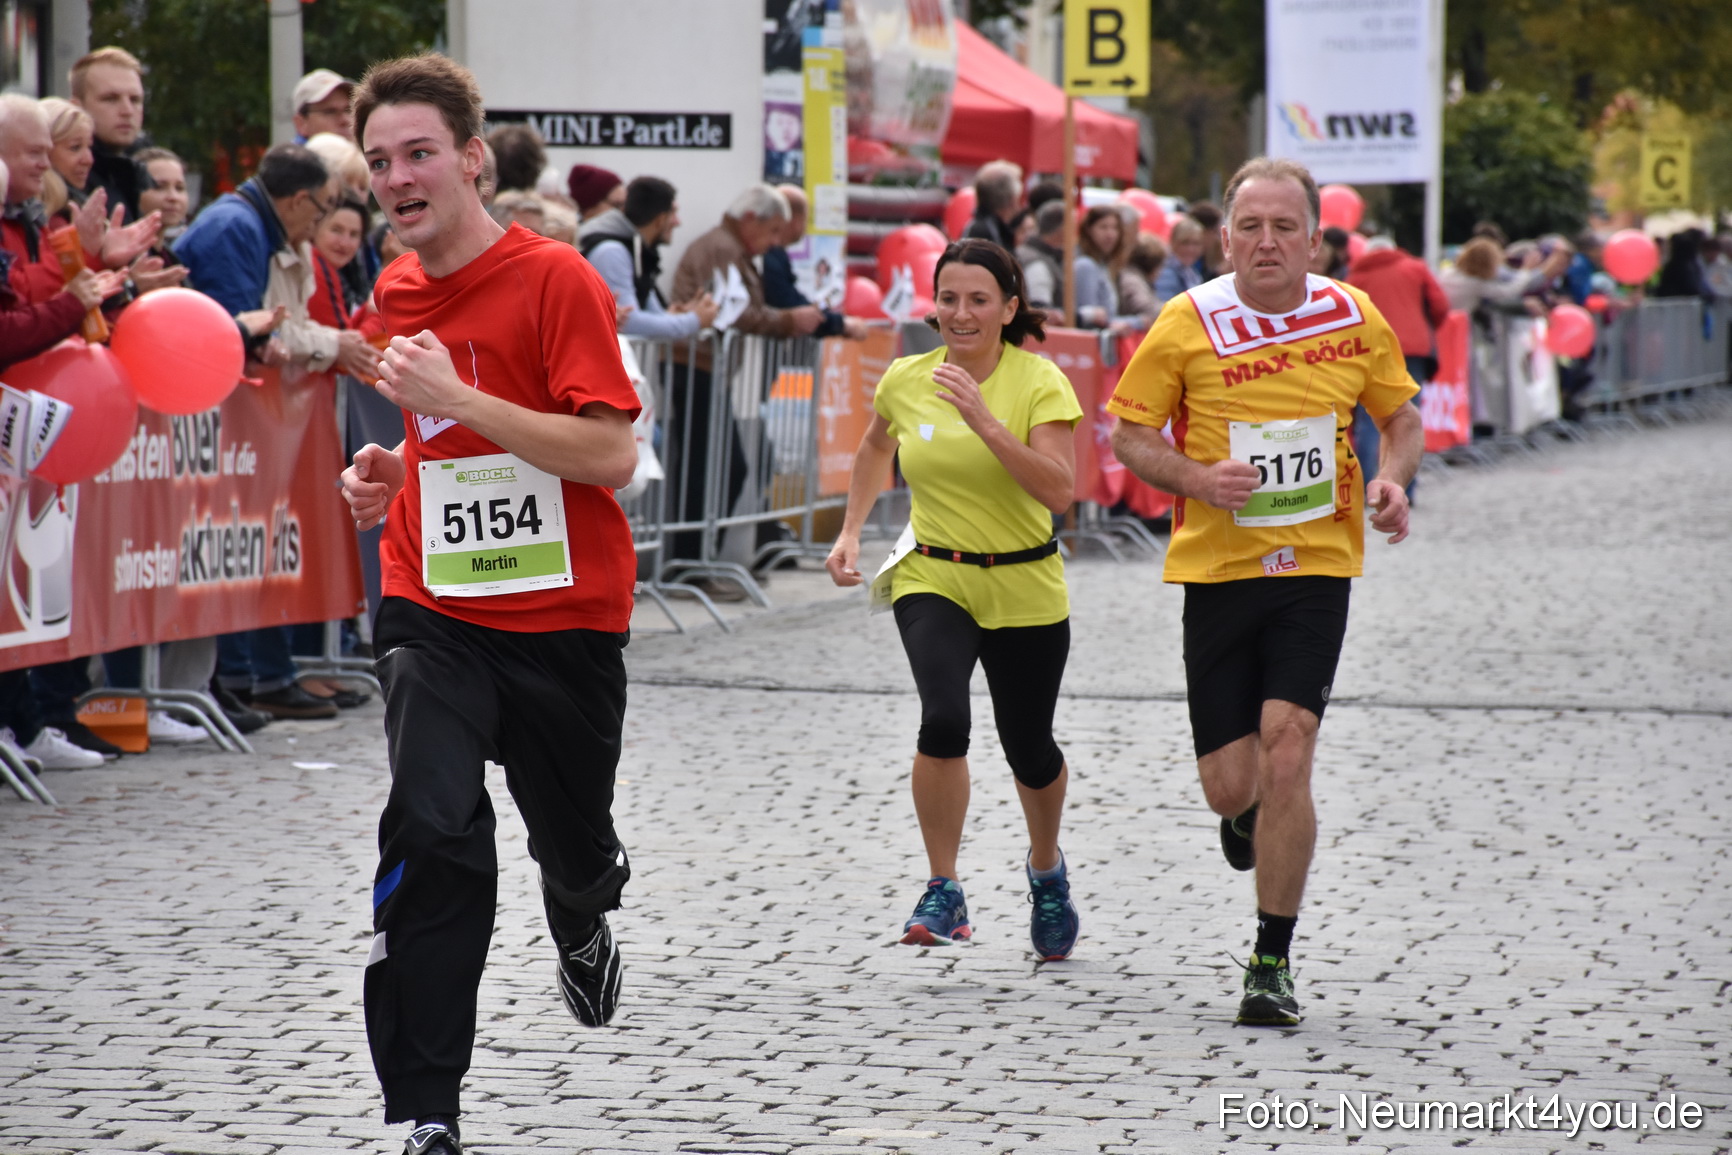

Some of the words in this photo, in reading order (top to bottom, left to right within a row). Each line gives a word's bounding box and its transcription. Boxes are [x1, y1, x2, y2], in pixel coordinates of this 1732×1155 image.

[1088, 8, 1125, 65] B
[484, 114, 723, 146] MINI-Partl.de
[1653, 155, 1677, 191] C
[1221, 352, 1296, 388] MAX
[1303, 339, 1371, 365] BÖGL
[467, 467, 516, 481] BOCK
[1249, 447, 1323, 485] 5176
[443, 494, 542, 544] 5154
[1270, 494, 1309, 509] Johann
[472, 554, 518, 573] Martin
